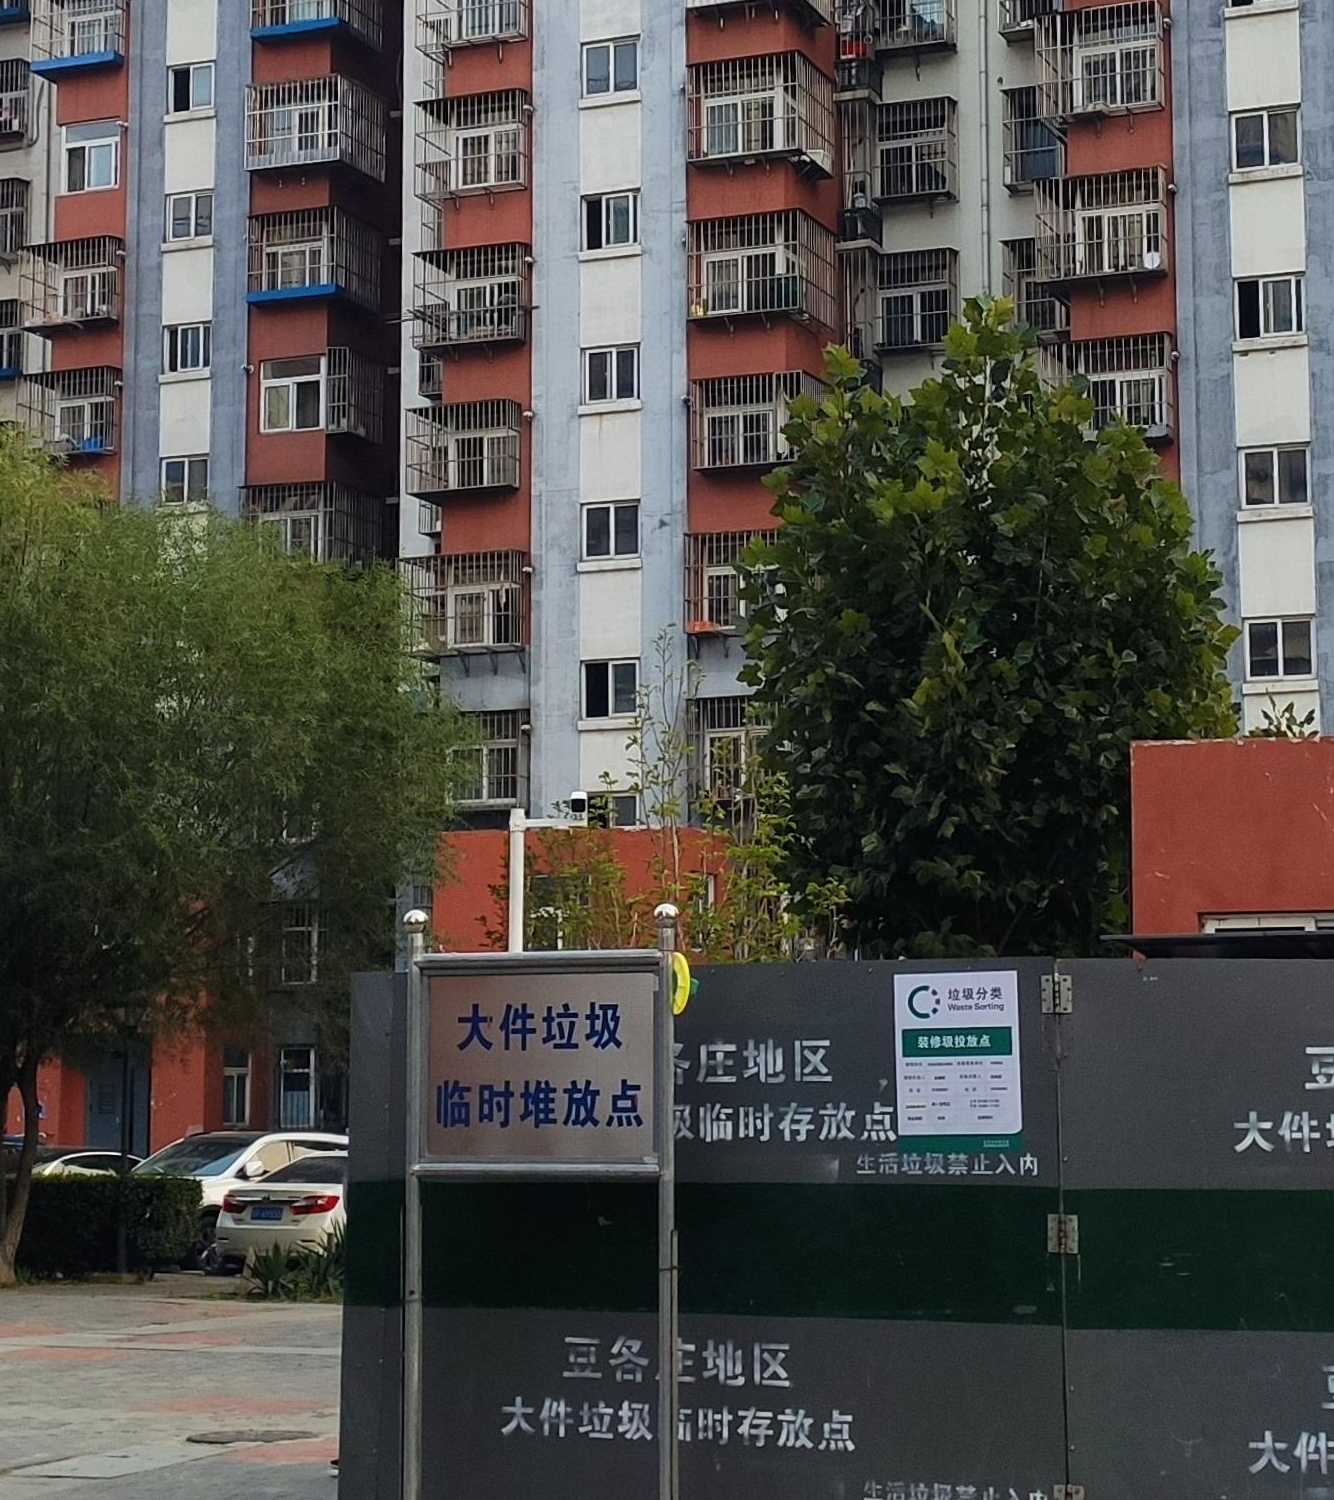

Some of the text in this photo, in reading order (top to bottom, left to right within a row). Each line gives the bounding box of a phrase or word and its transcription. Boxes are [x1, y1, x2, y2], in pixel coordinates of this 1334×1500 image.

[947, 987, 1003, 1001] 垃圾分类
[947, 1002, 1004, 1011] Waste Sorting
[457, 1002, 623, 1052] 大件垃圾
[436, 1080, 645, 1129] 临时堆放点
[856, 1152, 1038, 1176] 生活垃圾禁止入内
